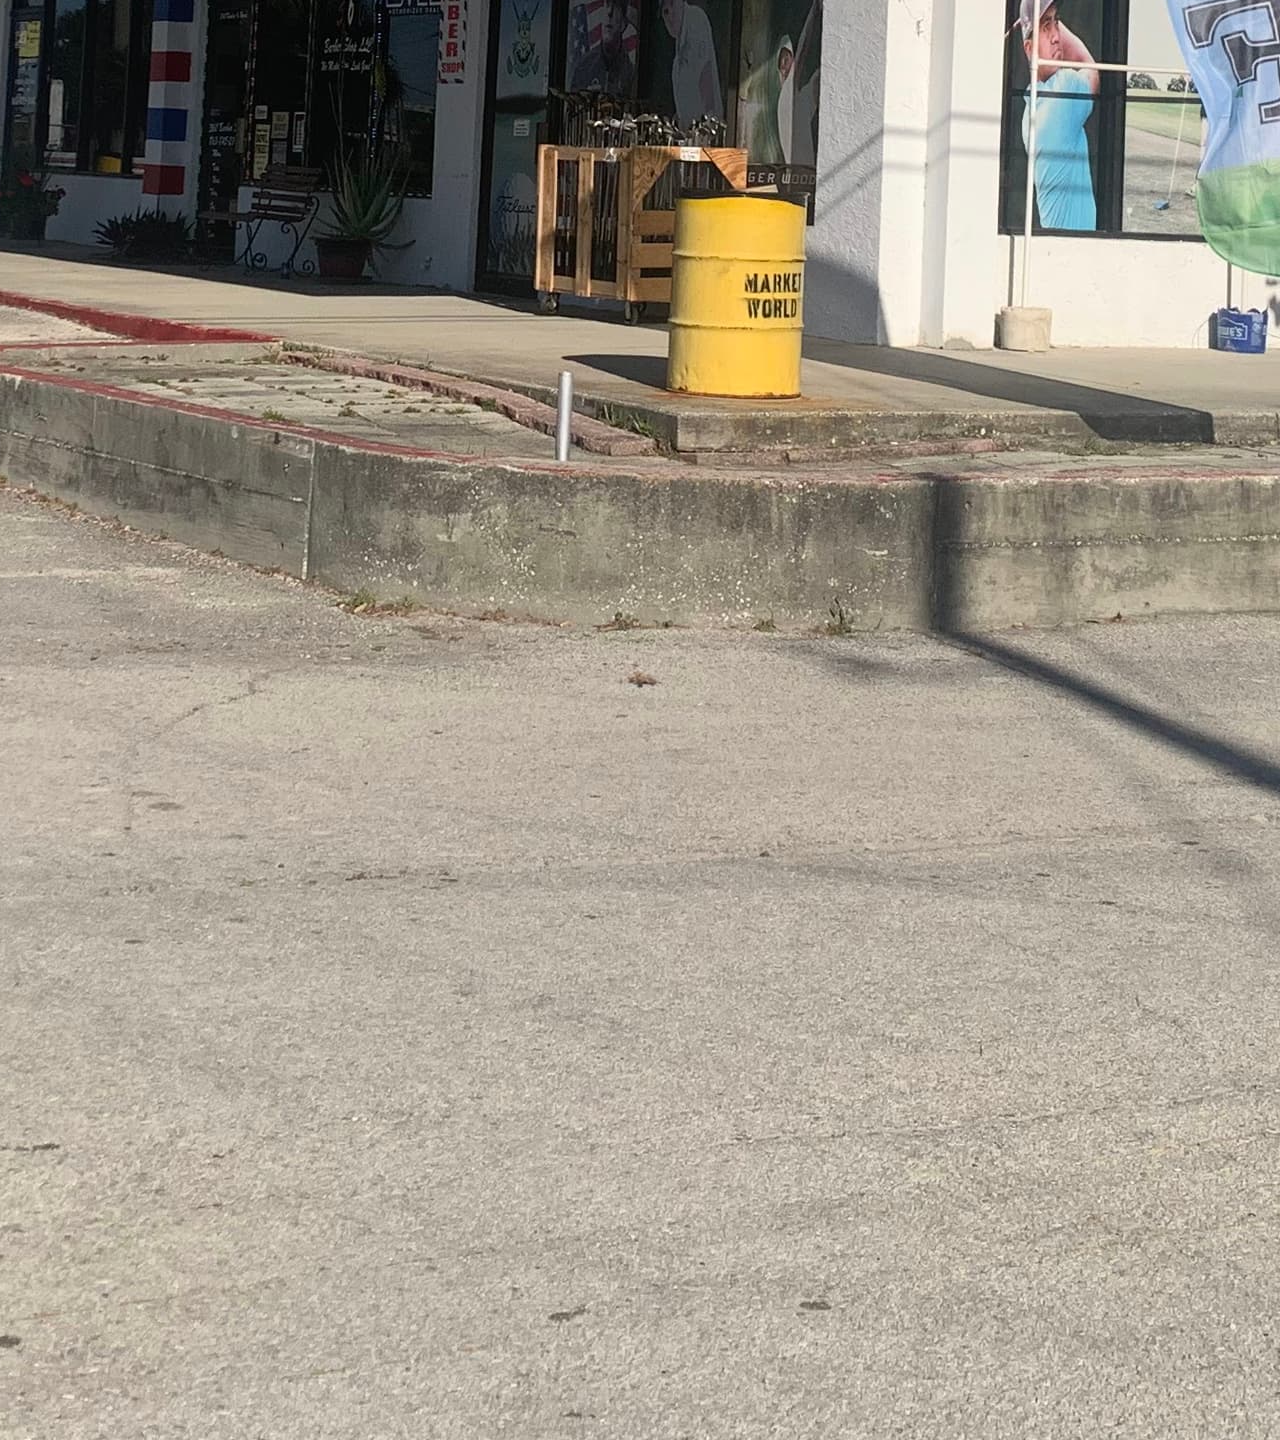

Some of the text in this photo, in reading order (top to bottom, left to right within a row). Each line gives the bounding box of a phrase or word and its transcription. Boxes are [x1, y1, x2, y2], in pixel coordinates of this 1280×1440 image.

[441, 62, 464, 74] SHOP
[748, 172, 816, 185] GER WOOD
[745, 272, 801, 293] MARKET
[747, 298, 797, 319] WORLD
